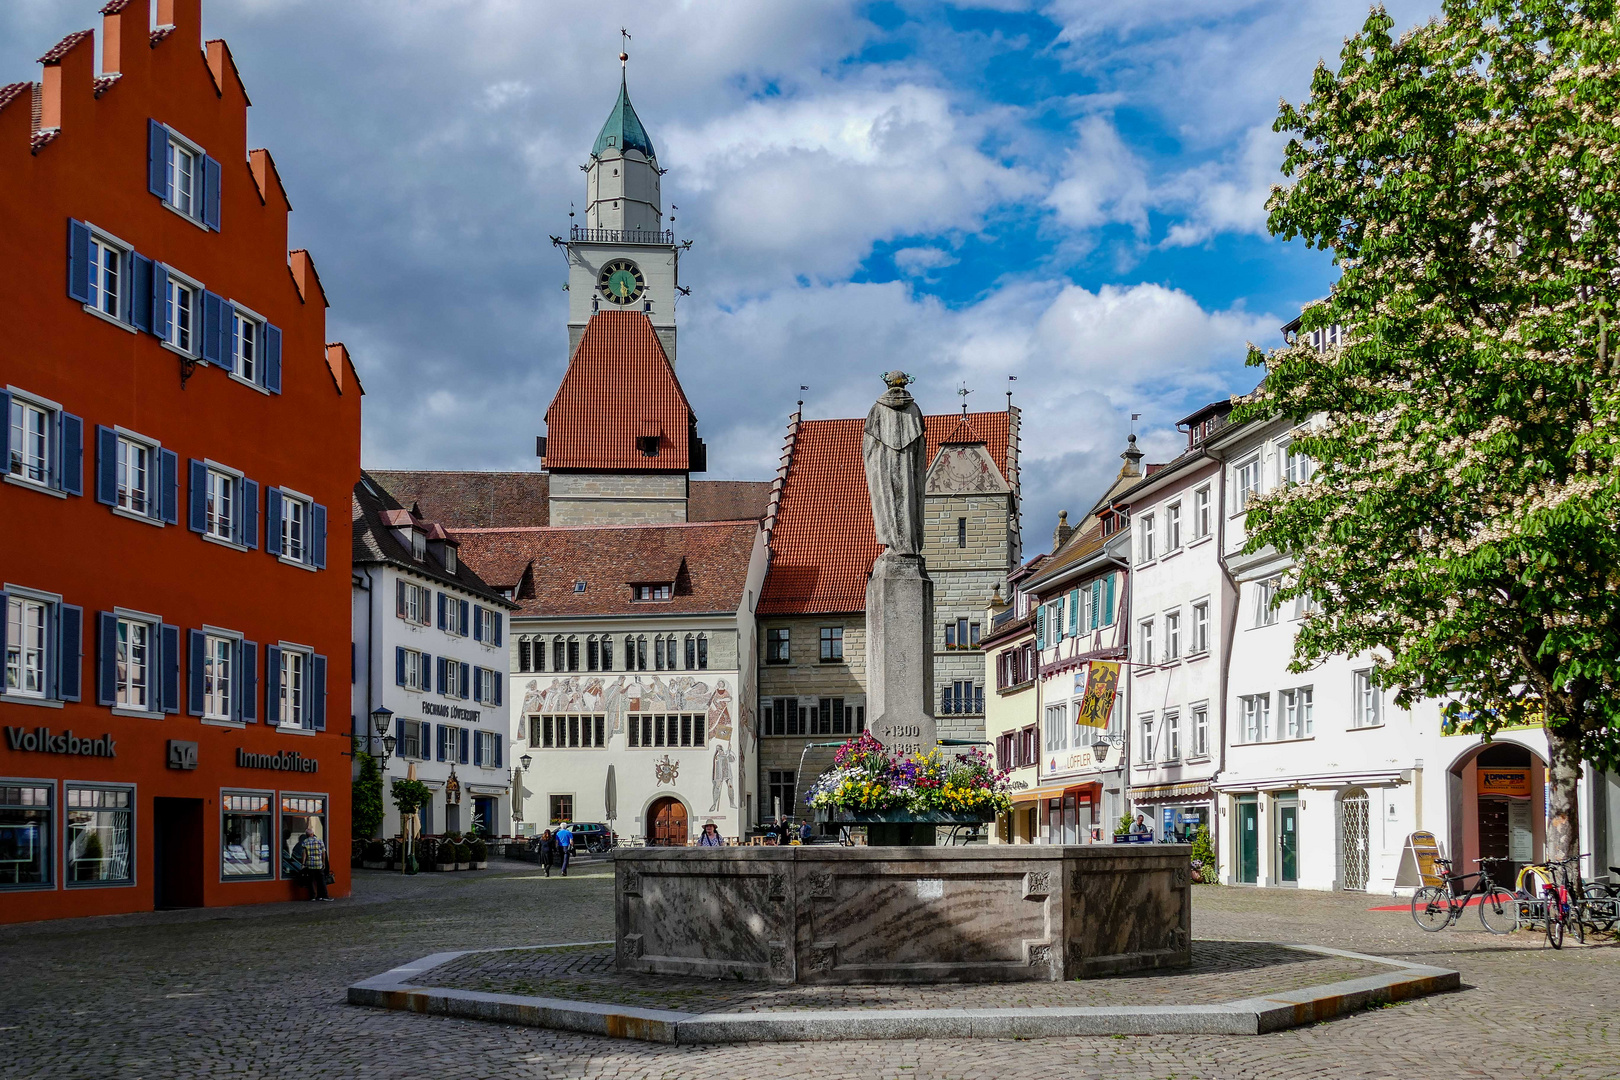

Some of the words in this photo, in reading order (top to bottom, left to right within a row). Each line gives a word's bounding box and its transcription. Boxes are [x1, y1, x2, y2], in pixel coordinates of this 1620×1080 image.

[892, 725, 920, 737] 1300
[6, 725, 117, 758] Volksbank
[892, 743, 920, 755] 1365
[237, 747, 319, 773] Immobilien
[1067, 753, 1092, 769] LÖFFLER
